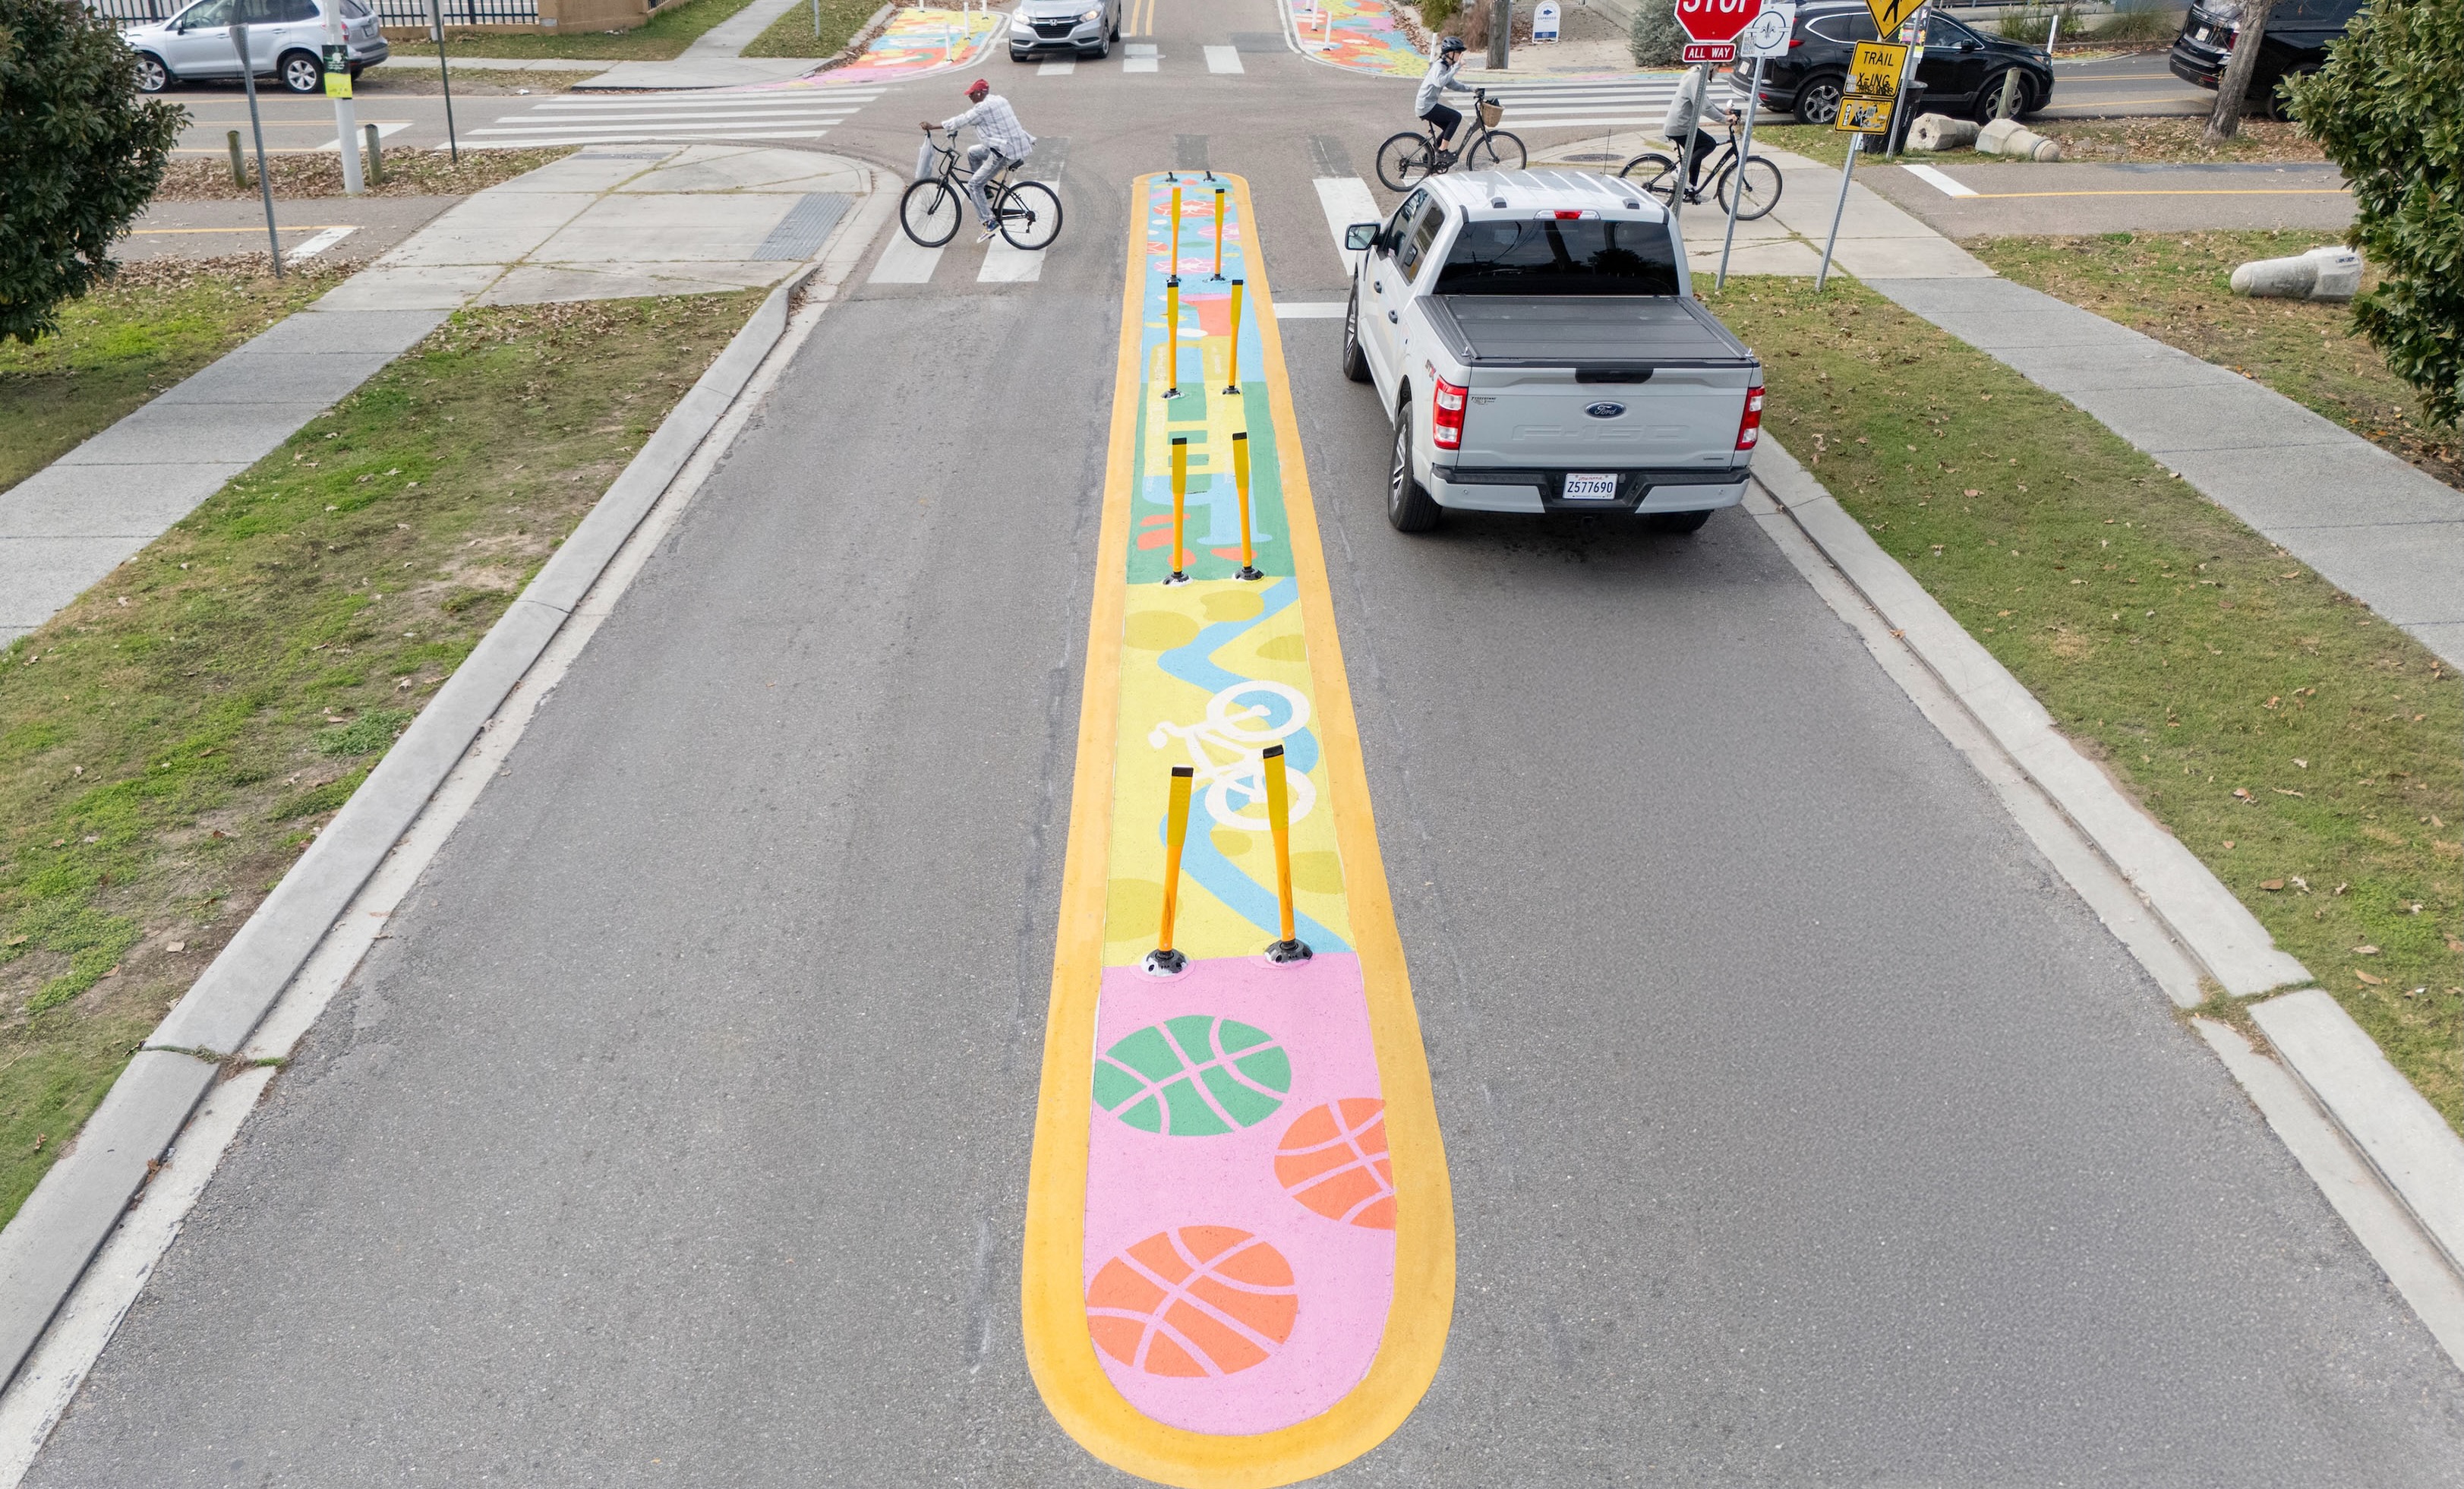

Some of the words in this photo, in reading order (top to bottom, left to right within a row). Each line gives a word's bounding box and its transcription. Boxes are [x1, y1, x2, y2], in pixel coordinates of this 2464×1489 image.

[1688, 48, 1705, 58] ALL
[1712, 47, 1730, 58] WAY
[1863, 51, 1894, 67] TRAIL
[1856, 72, 1890, 87] X-ING
[1595, 405, 1617, 415] Ford
[1567, 481, 1614, 493] Z577690
